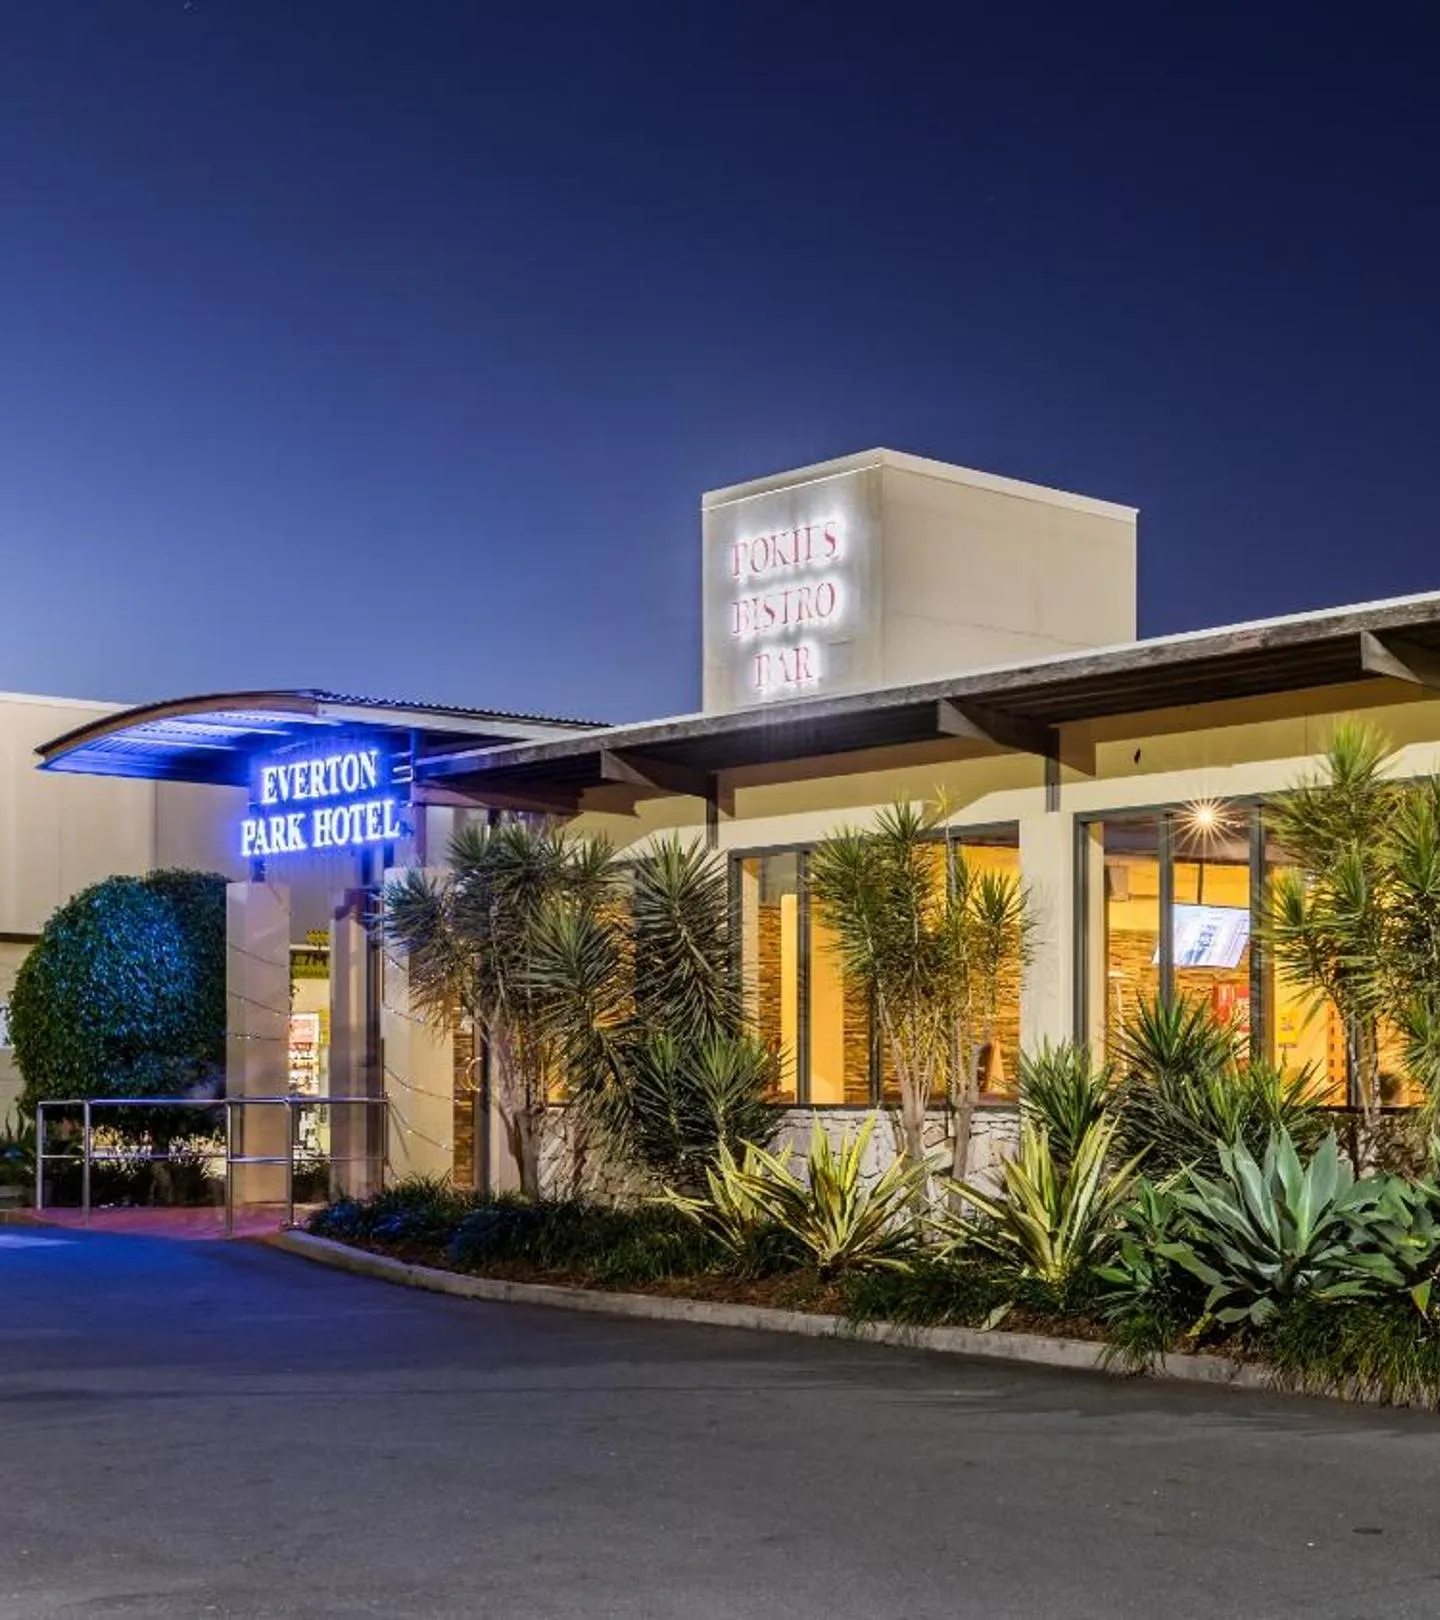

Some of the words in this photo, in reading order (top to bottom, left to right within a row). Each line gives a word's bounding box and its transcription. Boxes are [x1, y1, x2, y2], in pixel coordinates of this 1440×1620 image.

[260, 750, 377, 804] EVERTON
[241, 813, 307, 857] PARK
[312, 800, 400, 848] HOTEL
